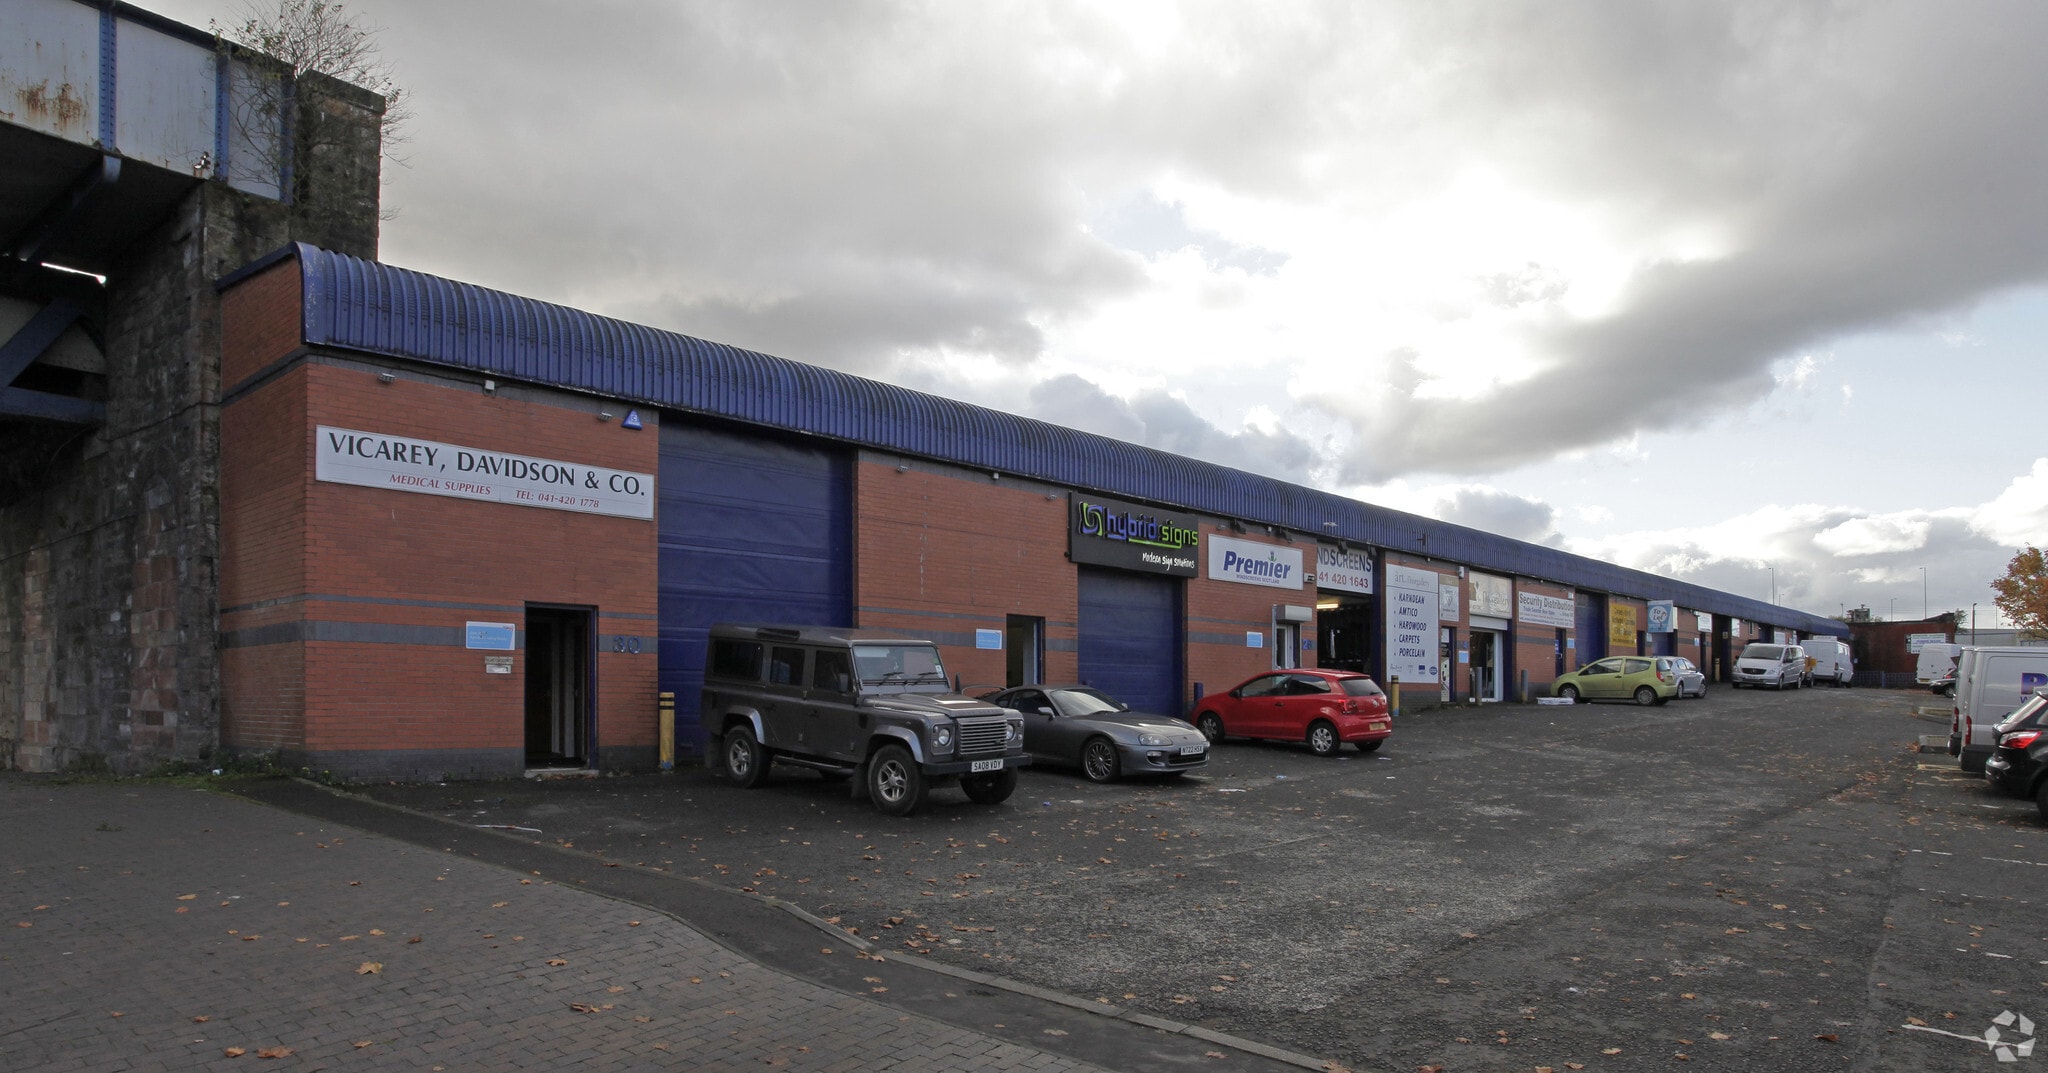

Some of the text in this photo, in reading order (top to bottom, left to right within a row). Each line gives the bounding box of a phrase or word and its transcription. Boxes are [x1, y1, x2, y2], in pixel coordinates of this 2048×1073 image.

[329, 432, 646, 496] VICAREY, DAVIDSON & CO.
[389, 473, 600, 509] MEDICAL SUPPLIES TEL: 041-420 1778
[1107, 513, 1199, 549] hybrid signs
[1162, 555, 1173, 571] Sign
[1223, 551, 1291, 579] Premier
[1331, 573, 1347, 585] 420
[1349, 576, 1369, 588] 1643
[1398, 593, 1425, 604] KARNDEAN
[1519, 593, 1573, 612] Security Distribution
[1399, 607, 1418, 617] AMTICO
[1398, 620, 1427, 631] HARDWOOD
[613, 635, 642, 654] 30
[1399, 634, 1420, 644] CARPETS
[1399, 648, 1425, 658] PORCELAIN
[974, 762, 989, 770] SA08
